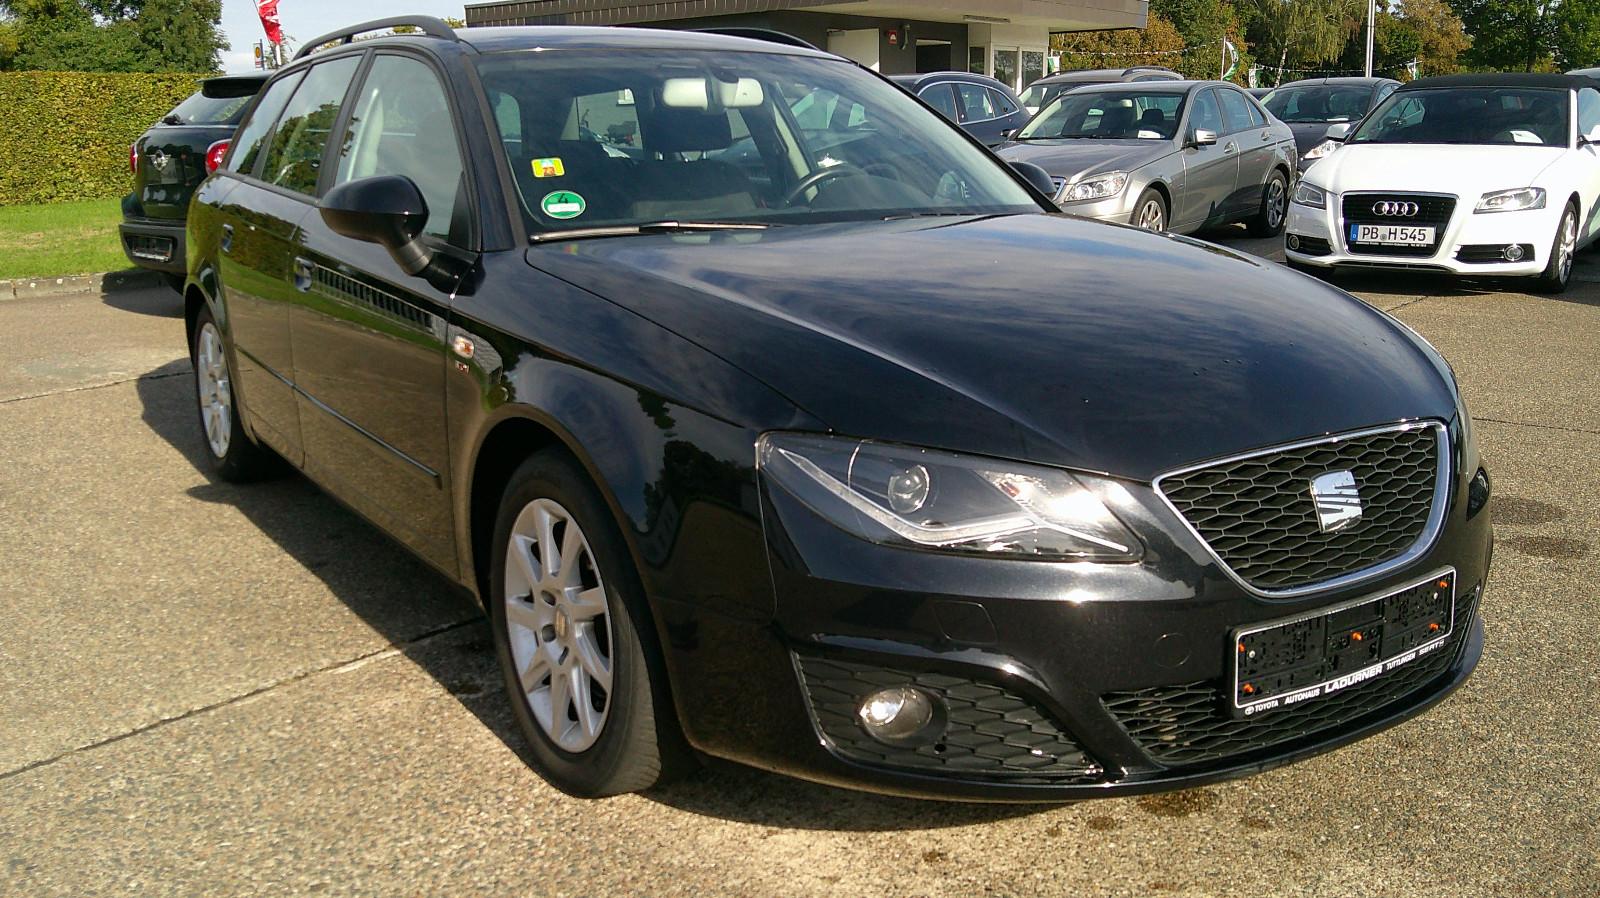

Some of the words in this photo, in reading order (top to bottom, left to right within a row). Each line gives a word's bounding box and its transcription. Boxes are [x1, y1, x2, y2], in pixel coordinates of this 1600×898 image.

[1362, 227, 1379, 240] PB
[1255, 699, 1279, 713] TOYOTA
[1284, 688, 1321, 705] AUTOHAUS
[1324, 664, 1383, 694] LADURNER
[1386, 651, 1416, 671] TUTTLINGEN
